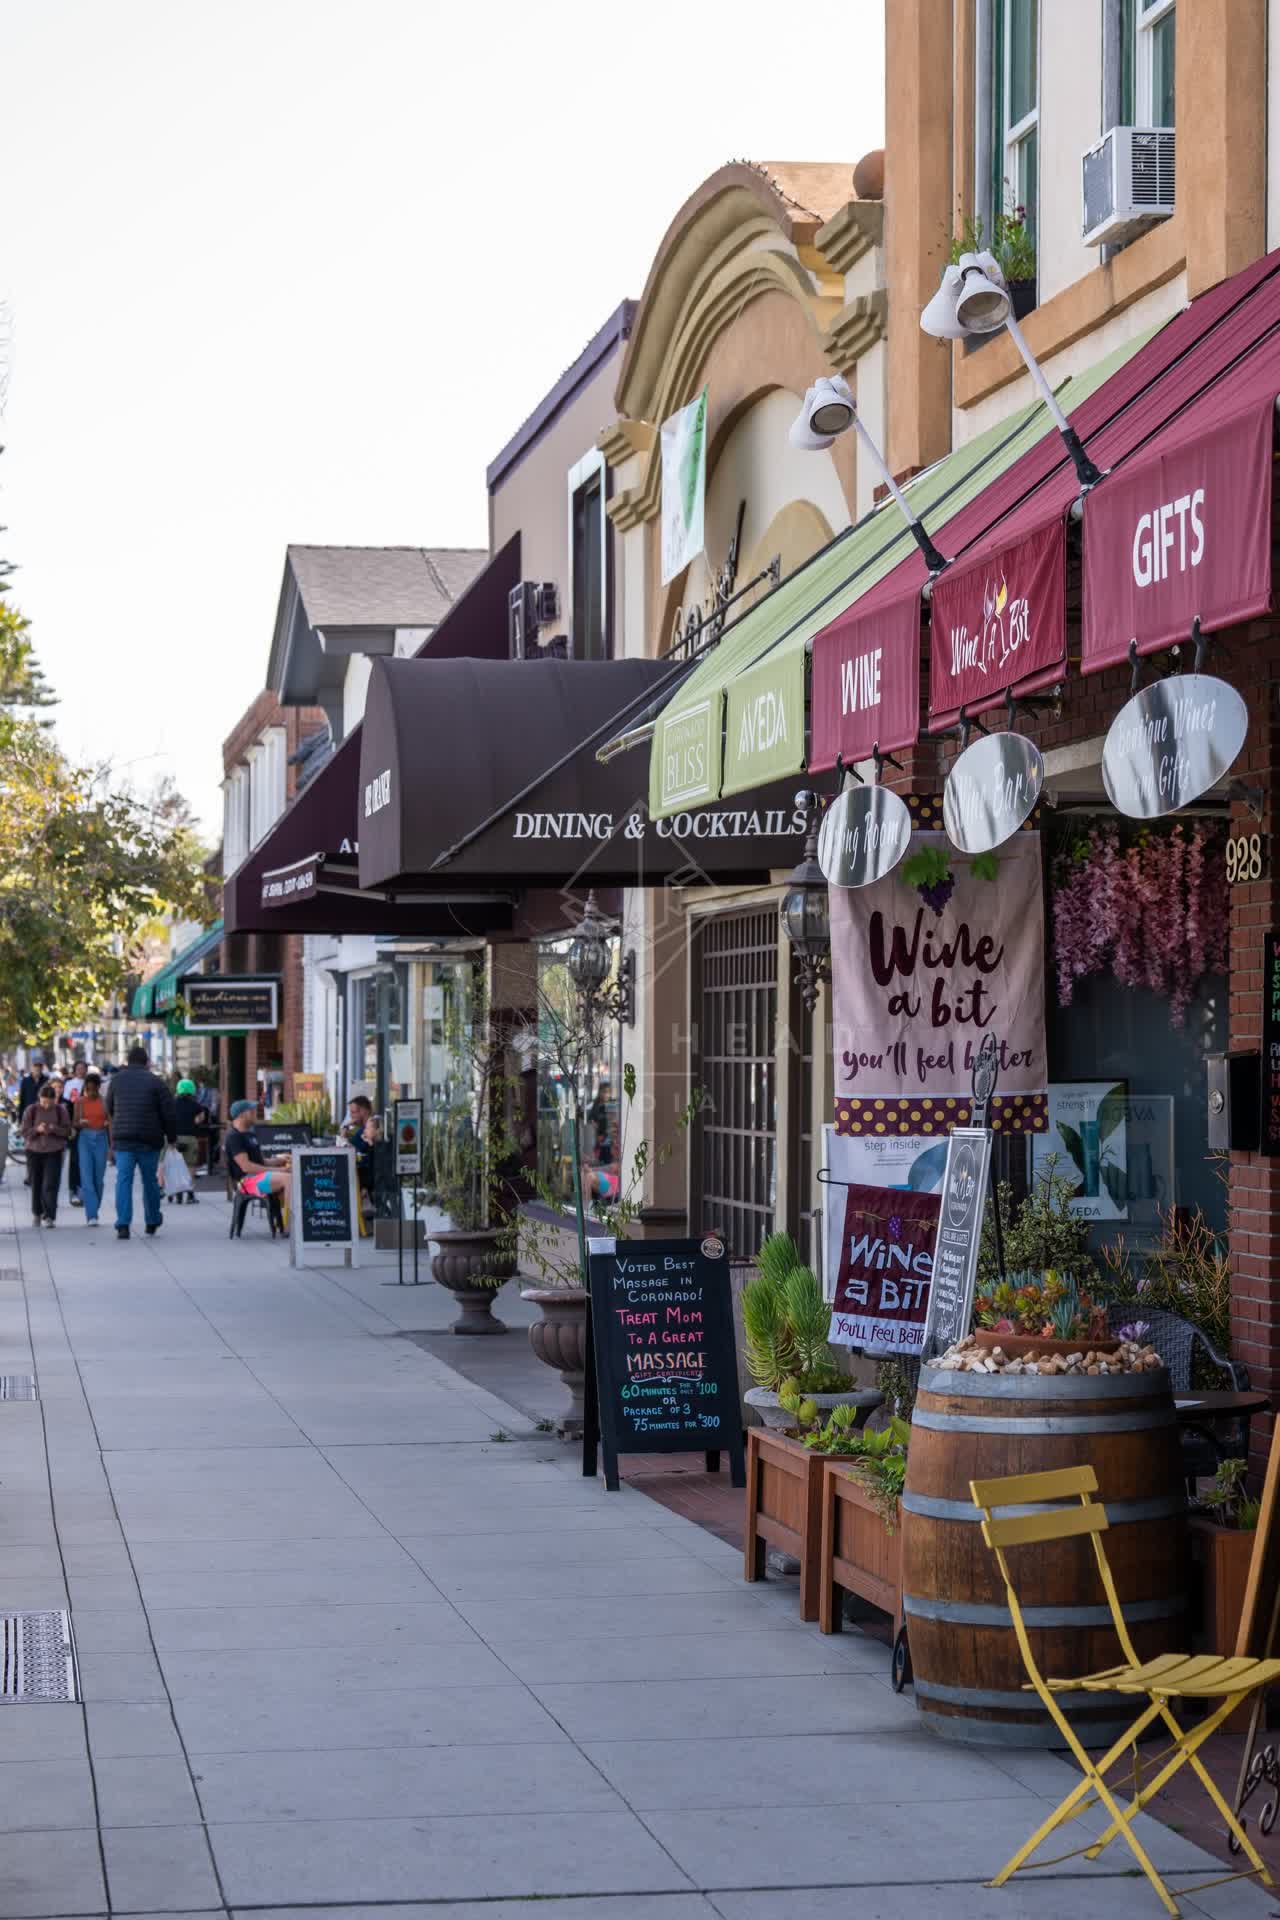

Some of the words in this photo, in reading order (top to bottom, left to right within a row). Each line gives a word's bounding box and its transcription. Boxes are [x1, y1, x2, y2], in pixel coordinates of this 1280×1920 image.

[1133, 489, 1204, 587] GIFTS
[951, 623, 979, 676] Wine
[1009, 599, 1030, 650] Bit
[841, 647, 882, 716] WINE
[737, 688, 788, 760] AVEDA
[1174, 697, 1217, 739] Wines
[667, 743, 704, 793] BLISS
[992, 761, 1023, 817] Bar
[1159, 750, 1191, 803] Gifts
[513, 813, 613, 838] DINING
[624, 813, 645, 839] &
[656, 809, 808, 838] COCKTAILS
[864, 811, 899, 854] Room
[1226, 834, 1262, 882] 928
[869, 907, 1004, 986] Wine
[888, 992, 921, 1018] a
[932, 977, 997, 1027] bit
[842, 1041, 907, 1080] you'll
[917, 1041, 955, 1083] feel
[864, 1140, 887, 1152] step
[890, 1139, 921, 1150] inside
[1066, 1206, 1101, 1217] VEDA
[680, 1277, 693, 1285] IN
[648, 1332, 657, 1345] A
[626, 1351, 709, 1372] MASSAGE
[621, 1384, 640, 1399] 60
[641, 1387, 677, 1397] MINUTES
[623, 1406, 663, 1416] PACKAGE
[670, 1406, 680, 1414] OF
[682, 1403, 691, 1415] 3
[662, 1396, 677, 1405] OR
[633, 1417, 648, 1431] 75
[649, 1421, 680, 1430] MINUTES
